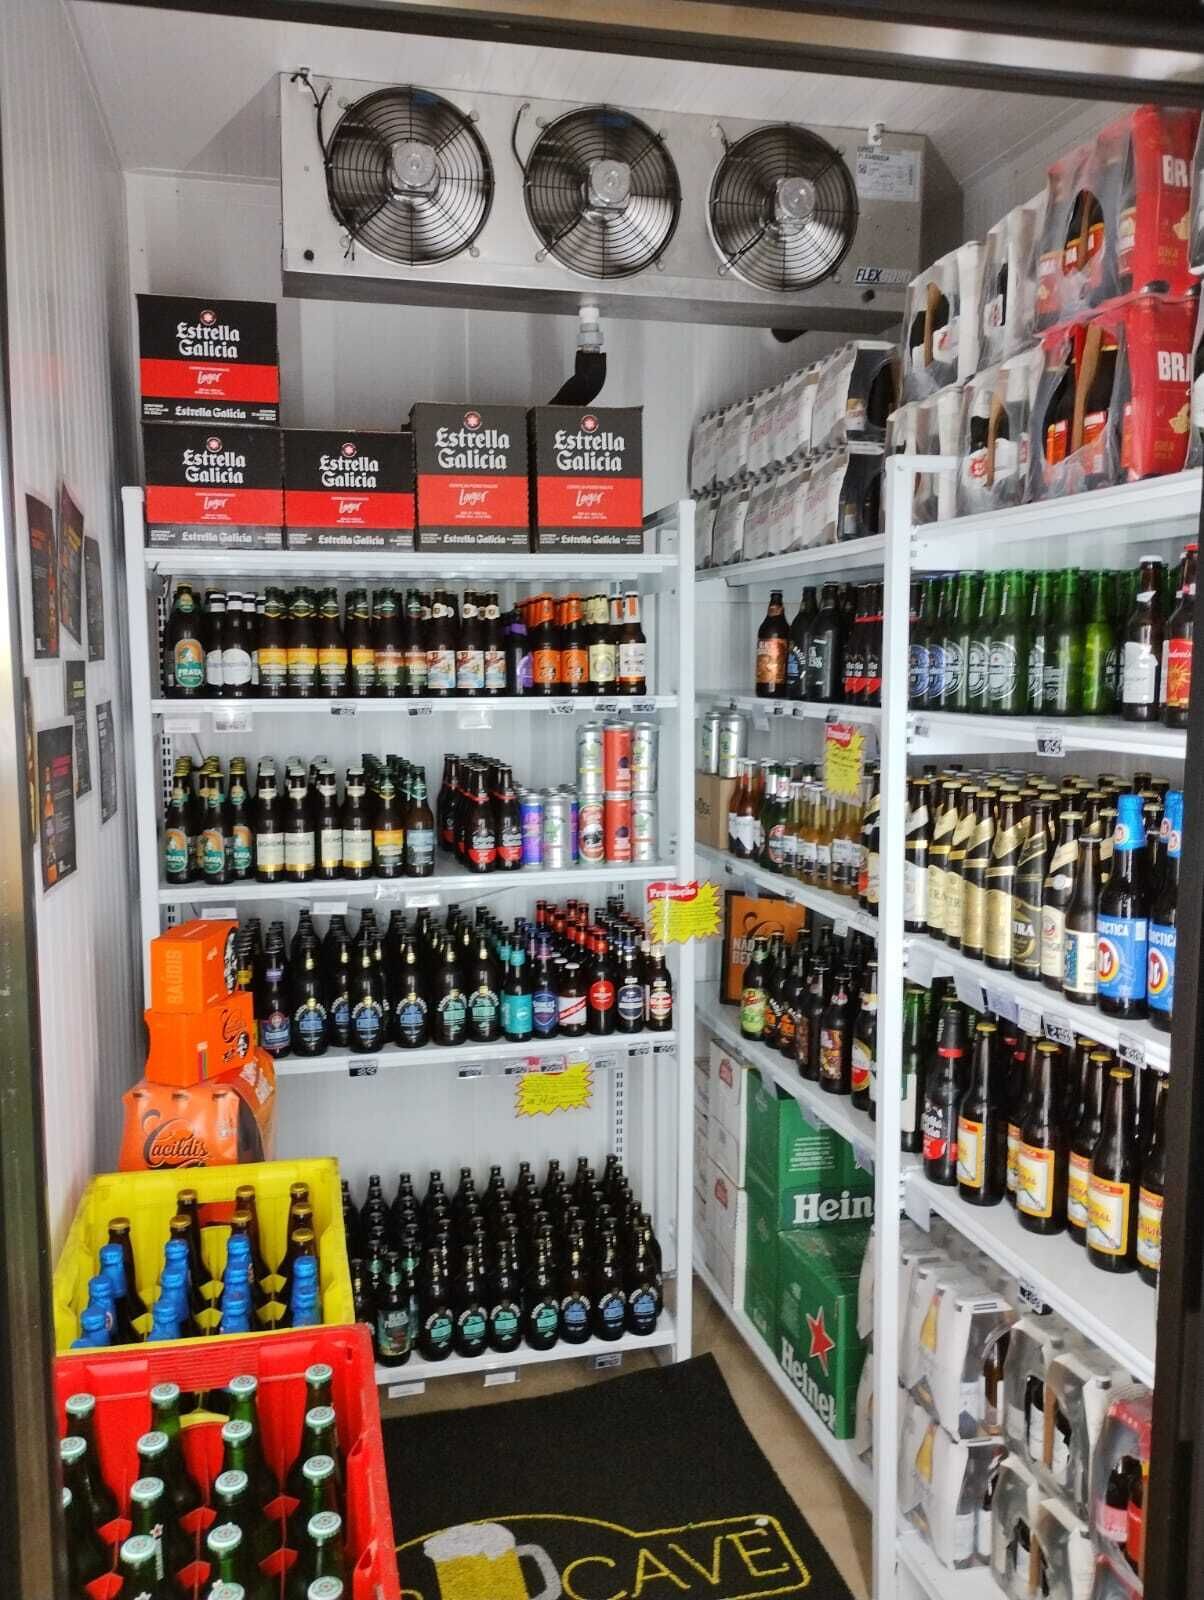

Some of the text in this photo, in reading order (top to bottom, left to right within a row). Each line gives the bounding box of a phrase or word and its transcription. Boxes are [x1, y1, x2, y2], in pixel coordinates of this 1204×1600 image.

[1162, 154, 1192, 188] BR
[176, 322, 240, 342] Estrella
[179, 342, 238, 359] Galicia
[175, 406, 212, 418] Estrella
[213, 408, 246, 419] Galicia
[434, 427, 510, 449] Estrella
[553, 429, 625, 451] Estrella
[182, 449, 246, 468] Estrella
[319, 455, 379, 472] Estrella
[437, 449, 507, 470] Galicia
[556, 451, 623, 472] Galicia
[185, 467, 244, 484] Galicia
[321, 471, 377, 489] Galicia
[793, 1190, 874, 1224] Hein
[561, 1528, 790, 1600] CAVE
